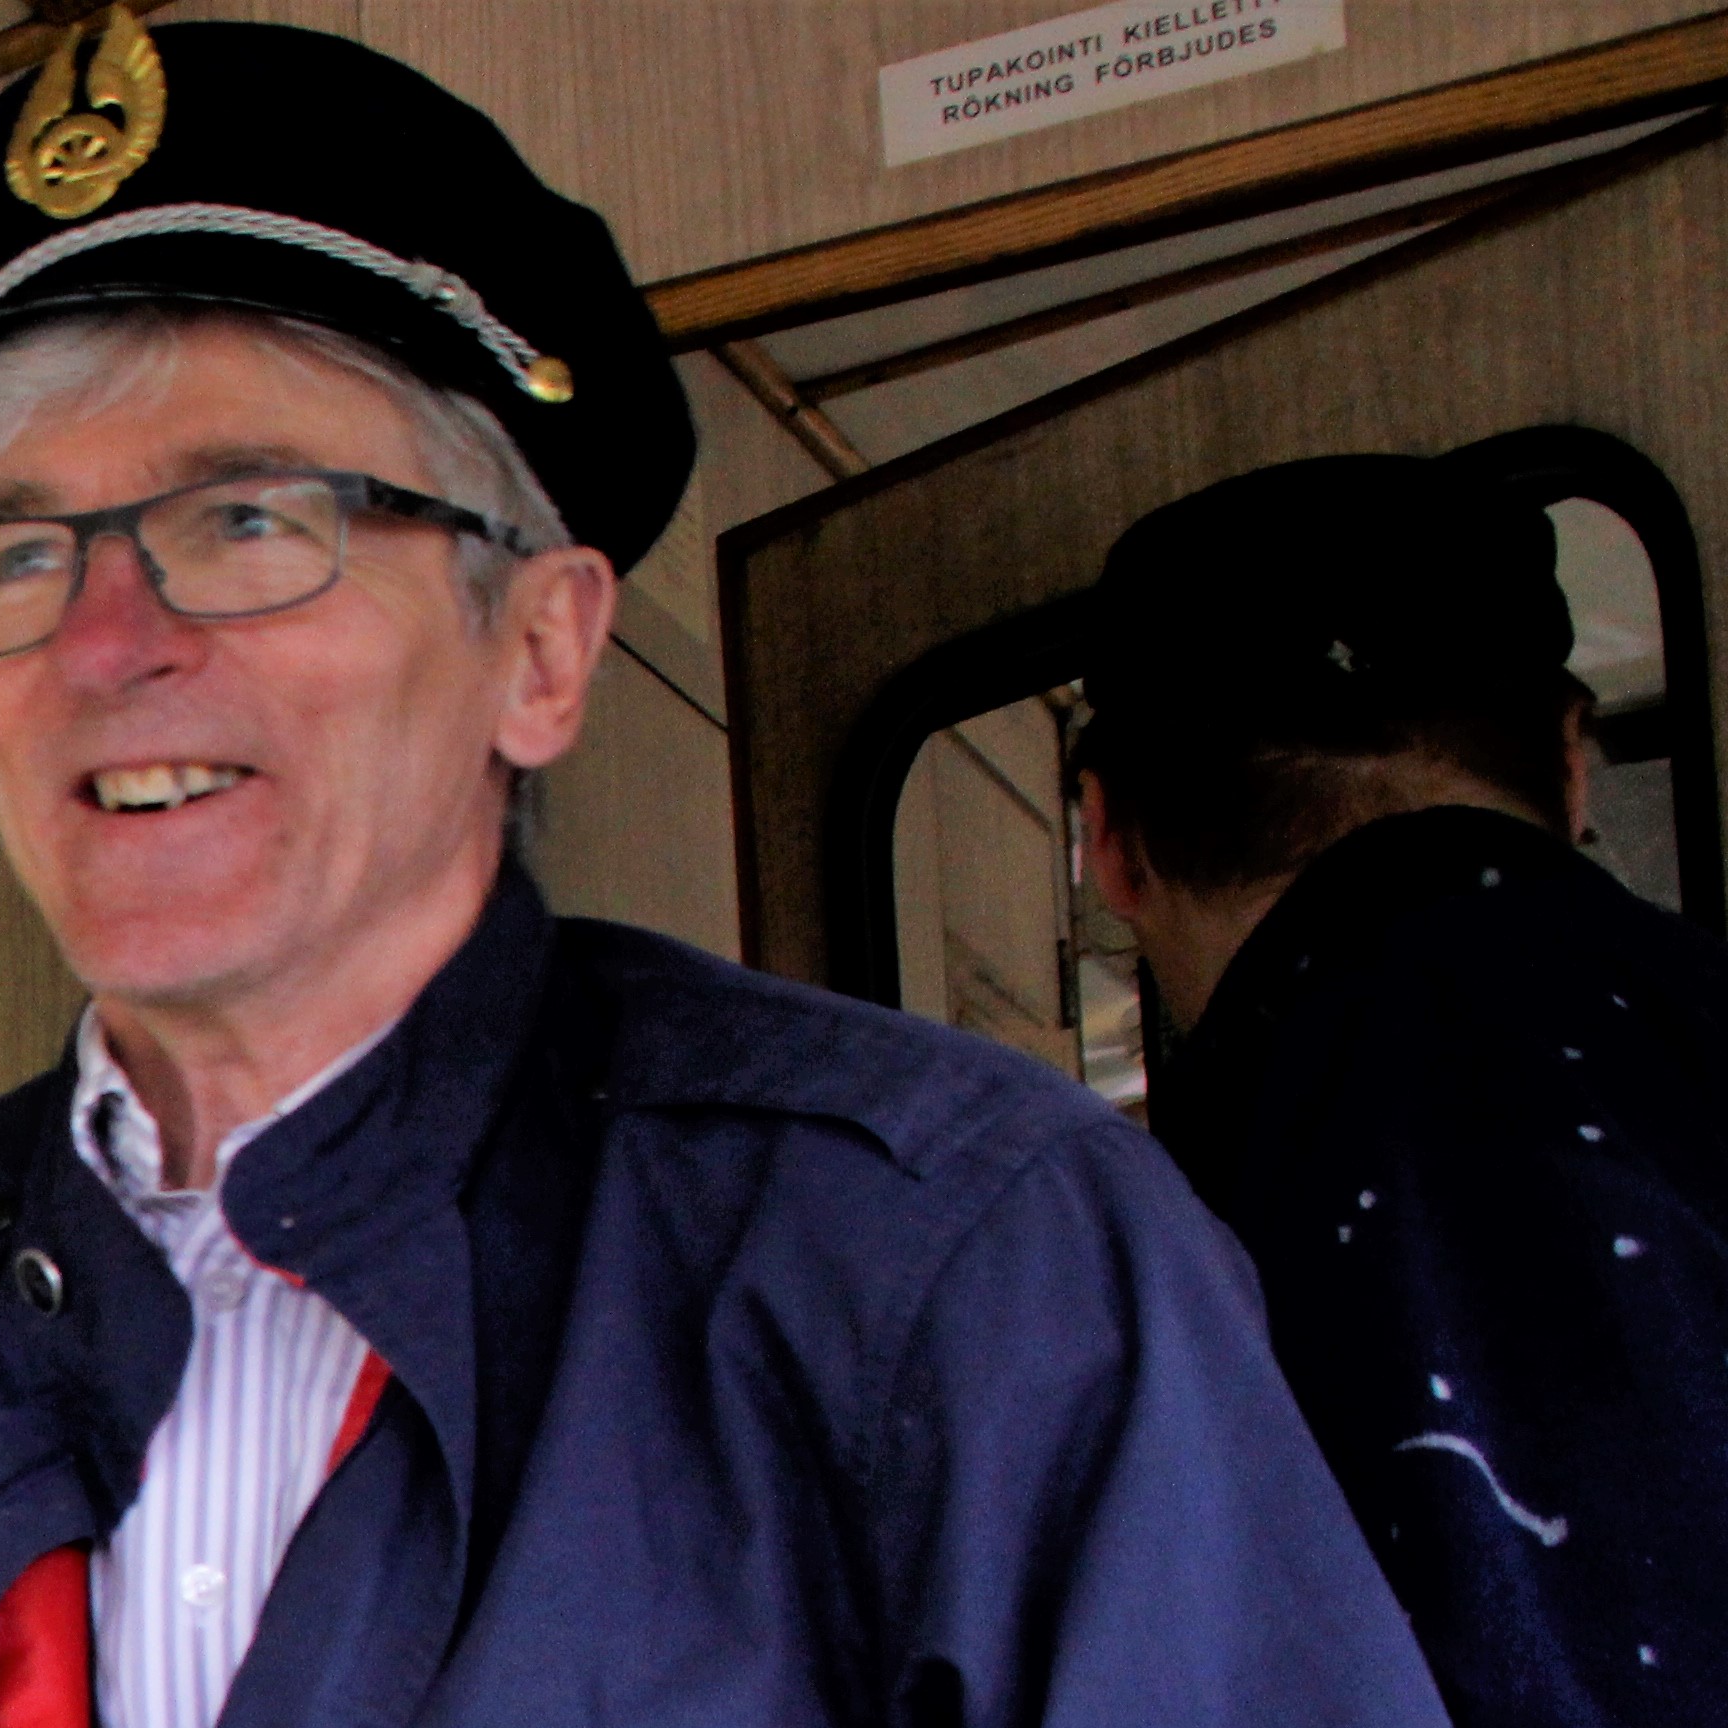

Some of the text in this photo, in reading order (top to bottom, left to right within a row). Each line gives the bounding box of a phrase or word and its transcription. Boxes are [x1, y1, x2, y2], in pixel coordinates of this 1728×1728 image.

[930, 0, 1280, 96] TUPAKOINTI KIELLET
[942, 17, 1278, 125] RÖKNING FÖRBJUDES
